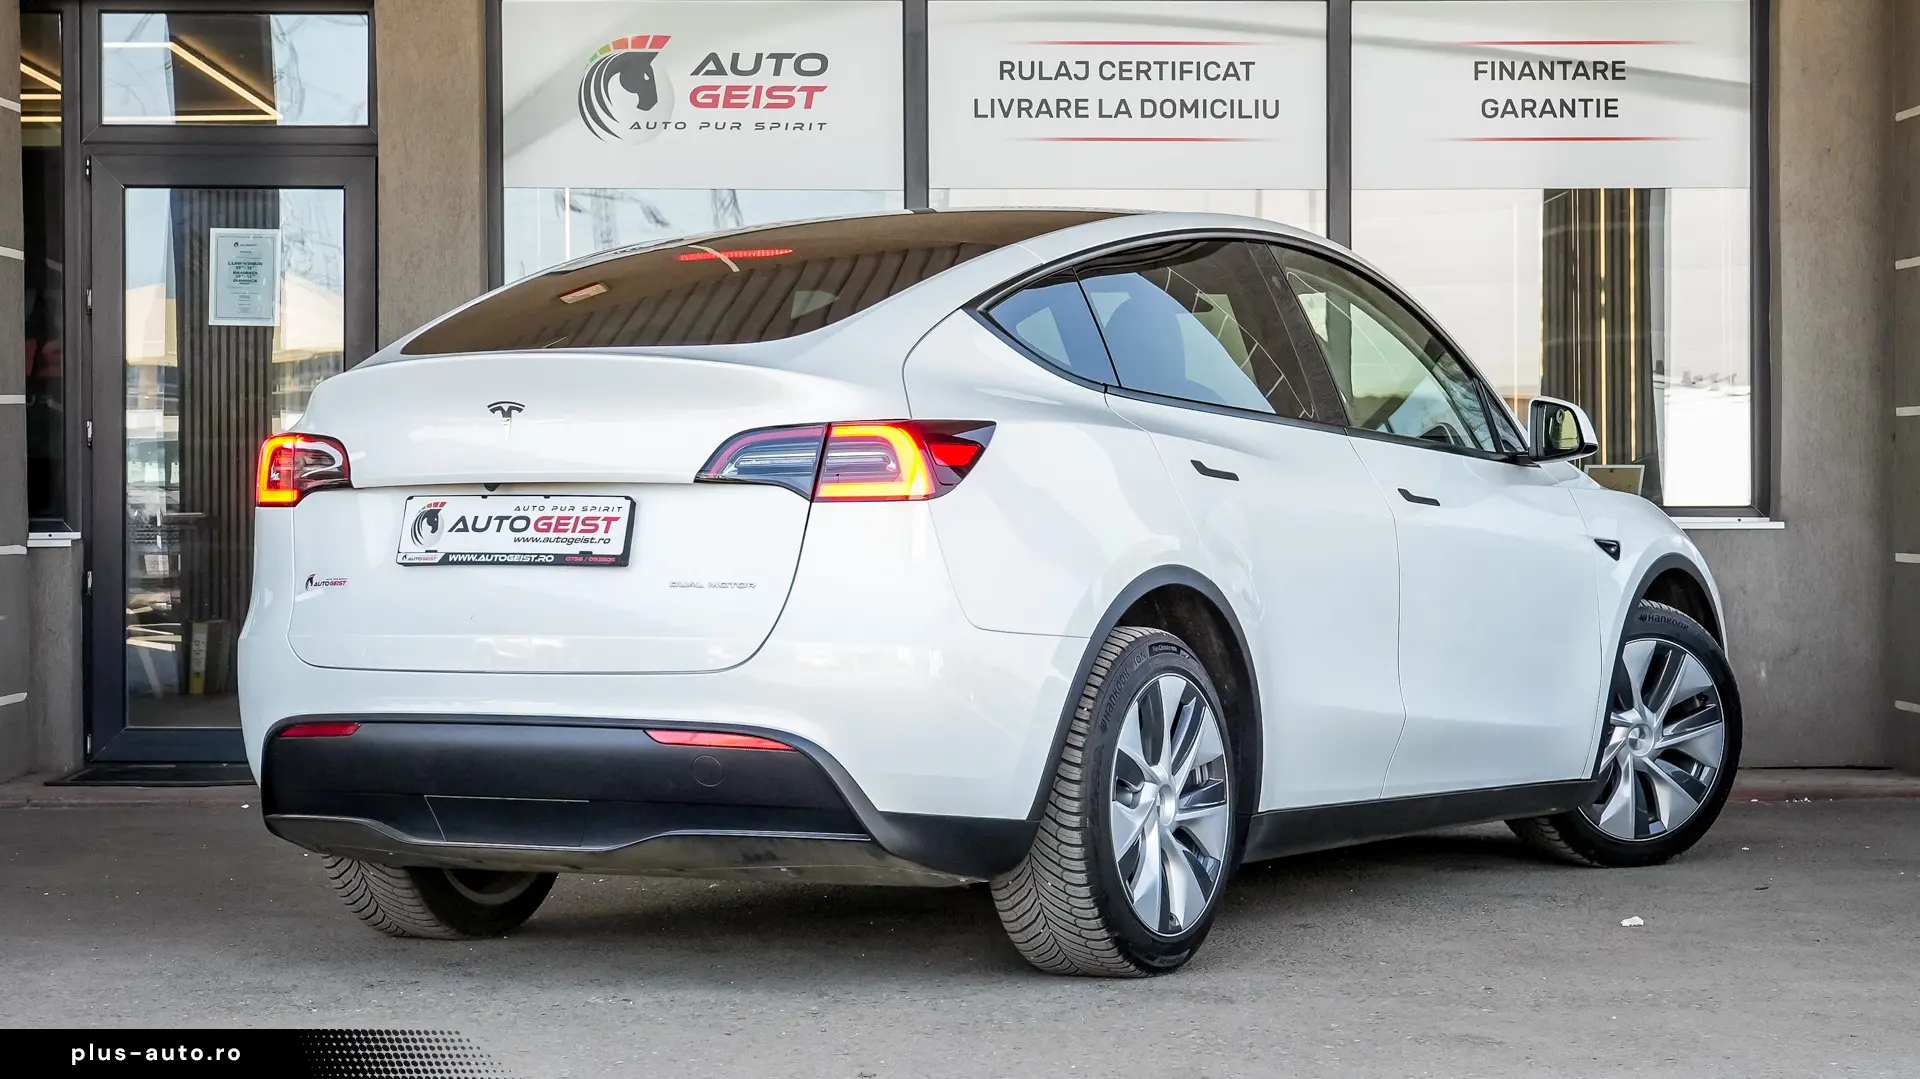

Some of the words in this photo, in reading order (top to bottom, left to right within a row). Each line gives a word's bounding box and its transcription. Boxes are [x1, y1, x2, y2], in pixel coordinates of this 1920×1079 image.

[690, 52, 829, 77] AUTO
[999, 60, 1090, 81] RULAJ
[1098, 60, 1256, 82] CERTIFICAT
[1473, 60, 1627, 81] FINANTARE
[689, 84, 828, 110] GEIST
[973, 98, 1090, 119] LIVRARE
[1098, 98, 1133, 119] LA
[1140, 98, 1280, 119] DOMICILIU
[1481, 98, 1619, 119] GARANTIE
[629, 121, 687, 131] AUTO
[699, 121, 742, 131] PUR
[754, 121, 828, 131] SPIRIT
[447, 515, 621, 534] AUTOGEIST
[513, 535, 611, 545] www.autogeist.ro
[448, 553, 554, 563] WWW.AUTOGEIST.RO
[707, 581, 756, 589] MOTOR
